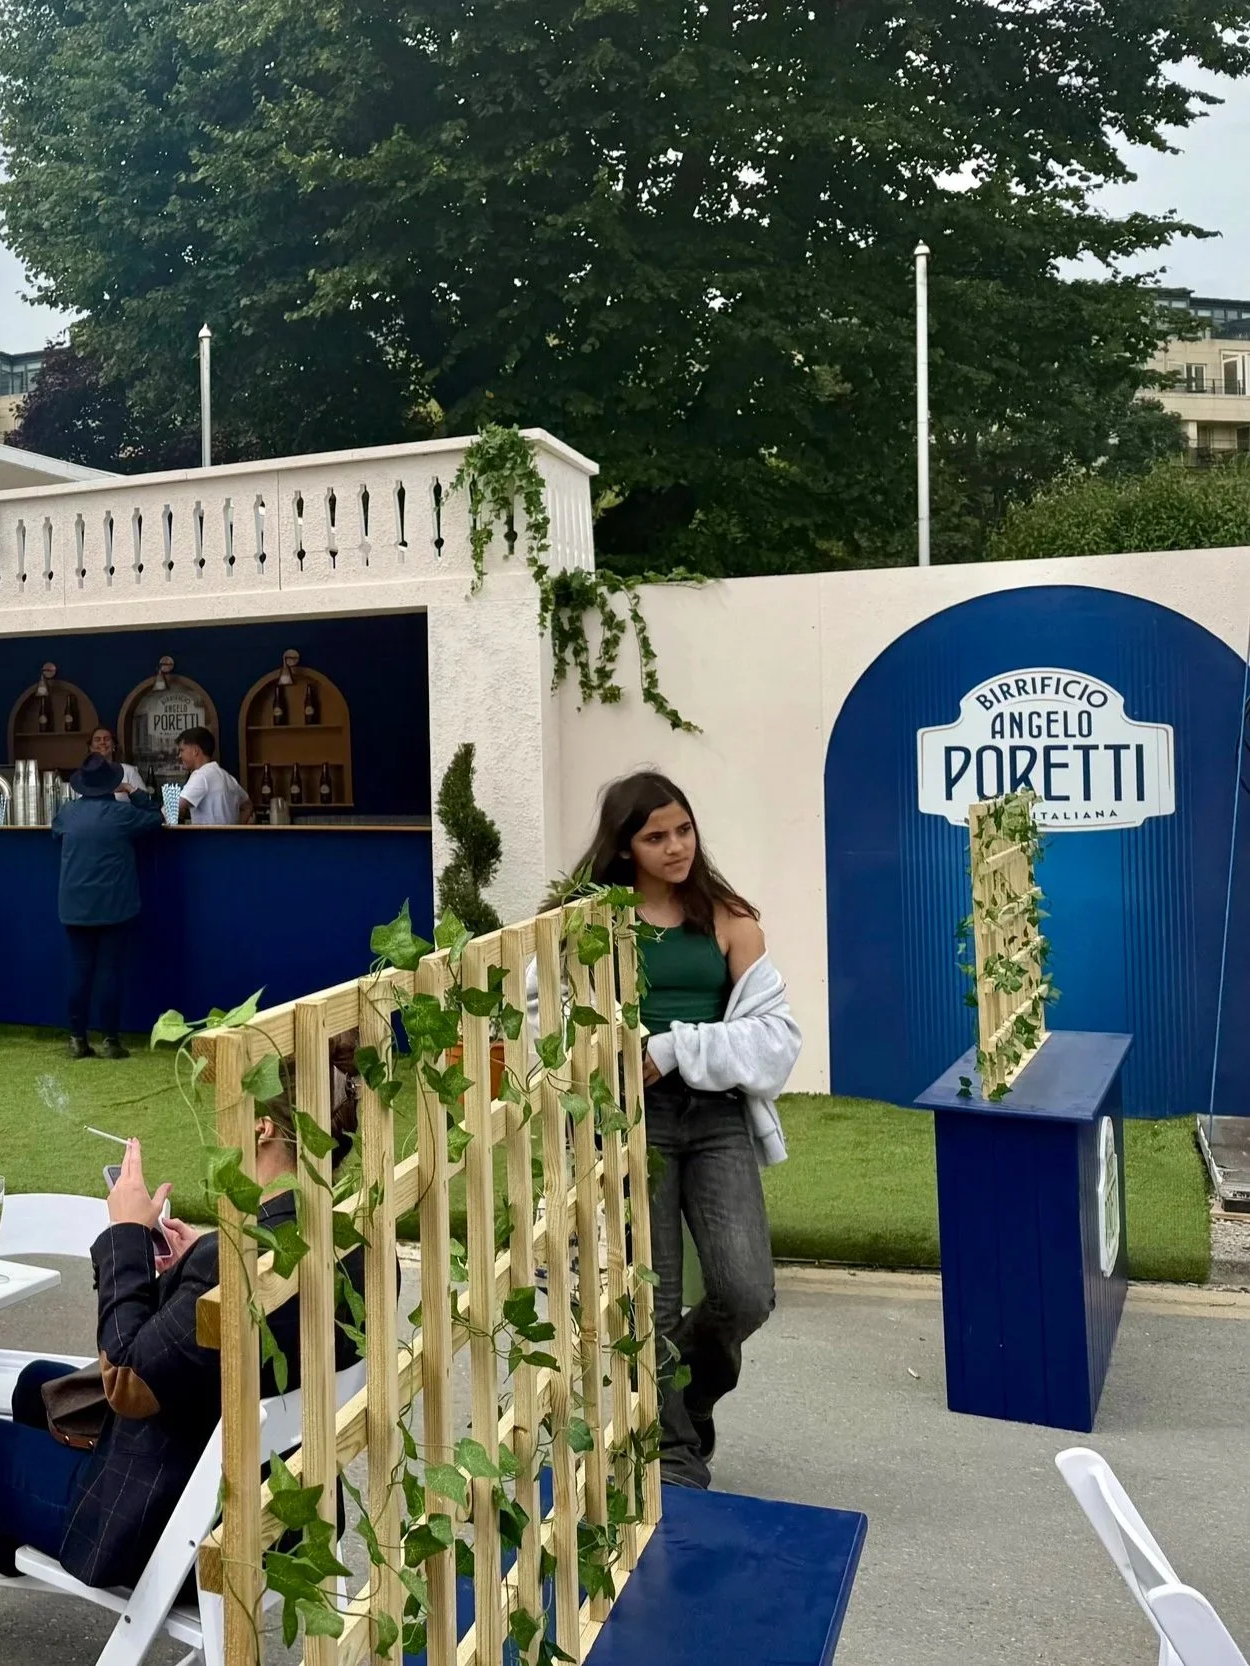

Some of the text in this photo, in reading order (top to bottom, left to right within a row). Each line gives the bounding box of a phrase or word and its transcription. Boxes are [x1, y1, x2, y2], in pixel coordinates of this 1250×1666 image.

[975, 676, 1109, 711] BIRRIFICIO
[153, 713, 199, 730] PORETTI
[991, 710, 1093, 739] ANGELO
[944, 743, 1145, 802] PORETTI
[1033, 809, 1118, 820] ITALIANA
